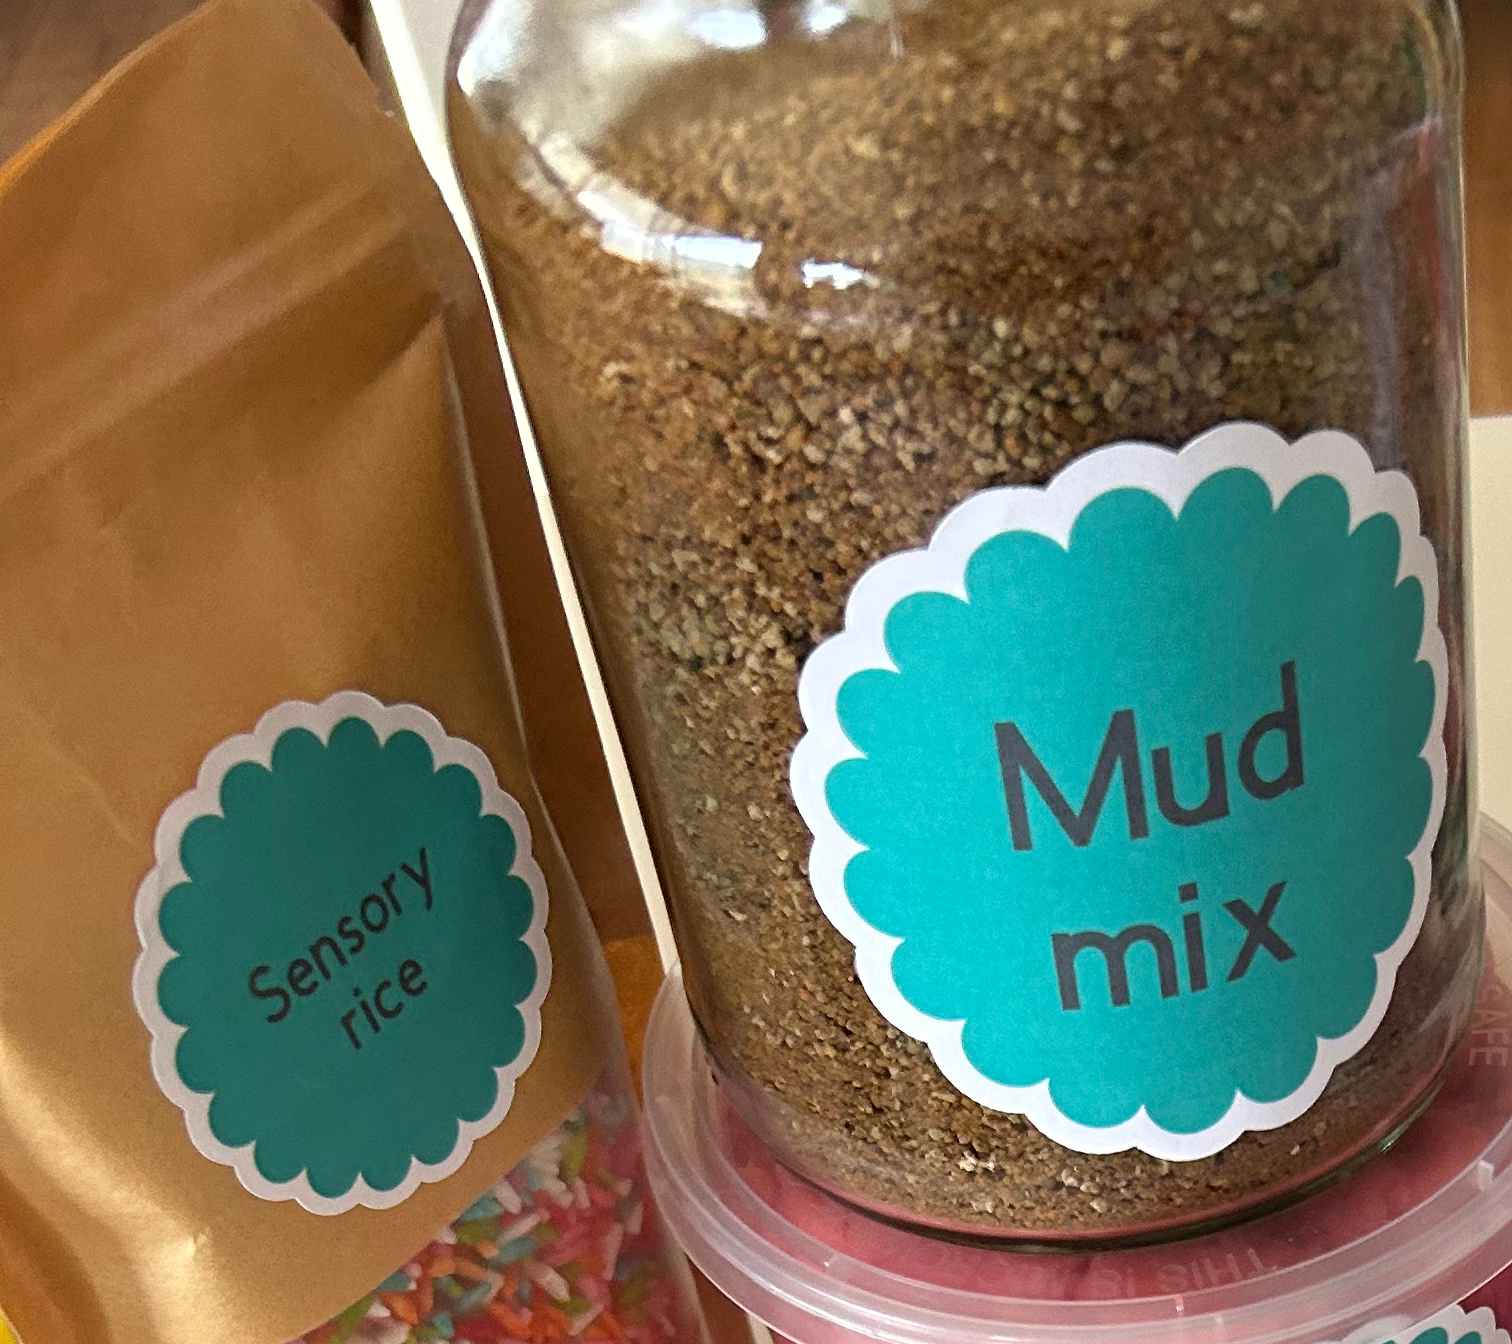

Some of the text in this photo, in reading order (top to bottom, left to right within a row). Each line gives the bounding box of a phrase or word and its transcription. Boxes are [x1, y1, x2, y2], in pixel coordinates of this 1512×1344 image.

[994, 659, 1305, 852] Mud
[249, 847, 433, 1024] Sensory
[339, 959, 428, 1049] rice
[1050, 880, 1298, 1012] mix
